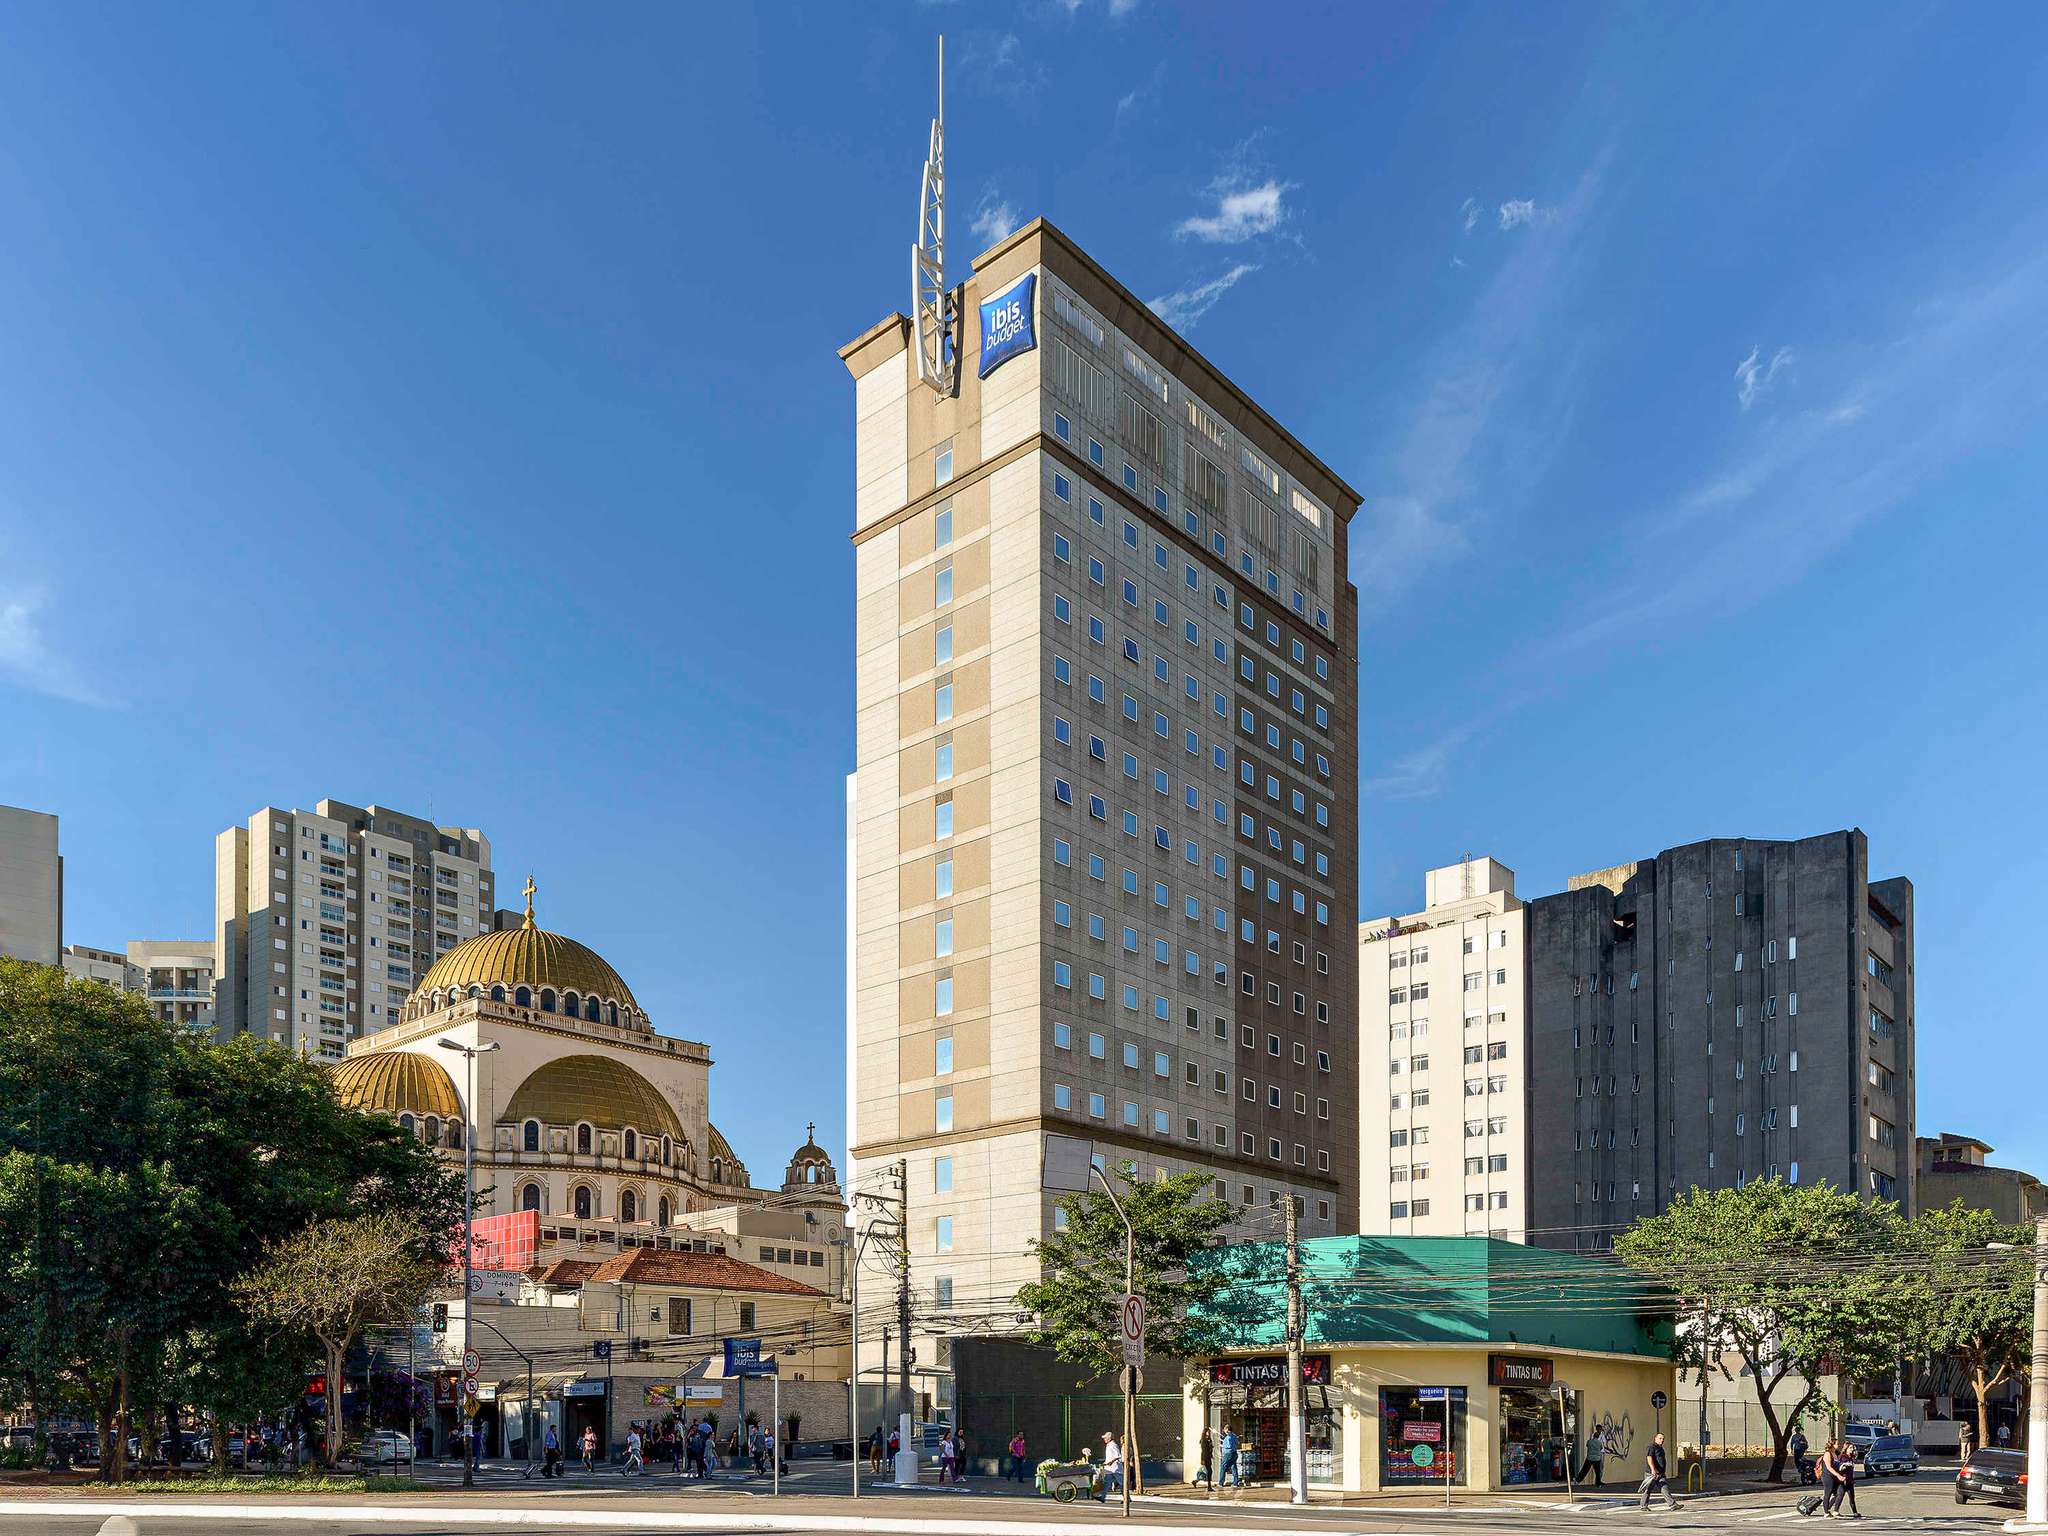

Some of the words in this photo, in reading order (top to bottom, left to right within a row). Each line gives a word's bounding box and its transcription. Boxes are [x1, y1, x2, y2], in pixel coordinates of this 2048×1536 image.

[992, 301, 1020, 333] ibis
[986, 315, 1025, 350] budget
[466, 1355, 477, 1367] 50
[1233, 1365, 1278, 1379] TINTAS
[1506, 1365, 1530, 1379] TINTAS
[1531, 1367, 1543, 1380] MC
